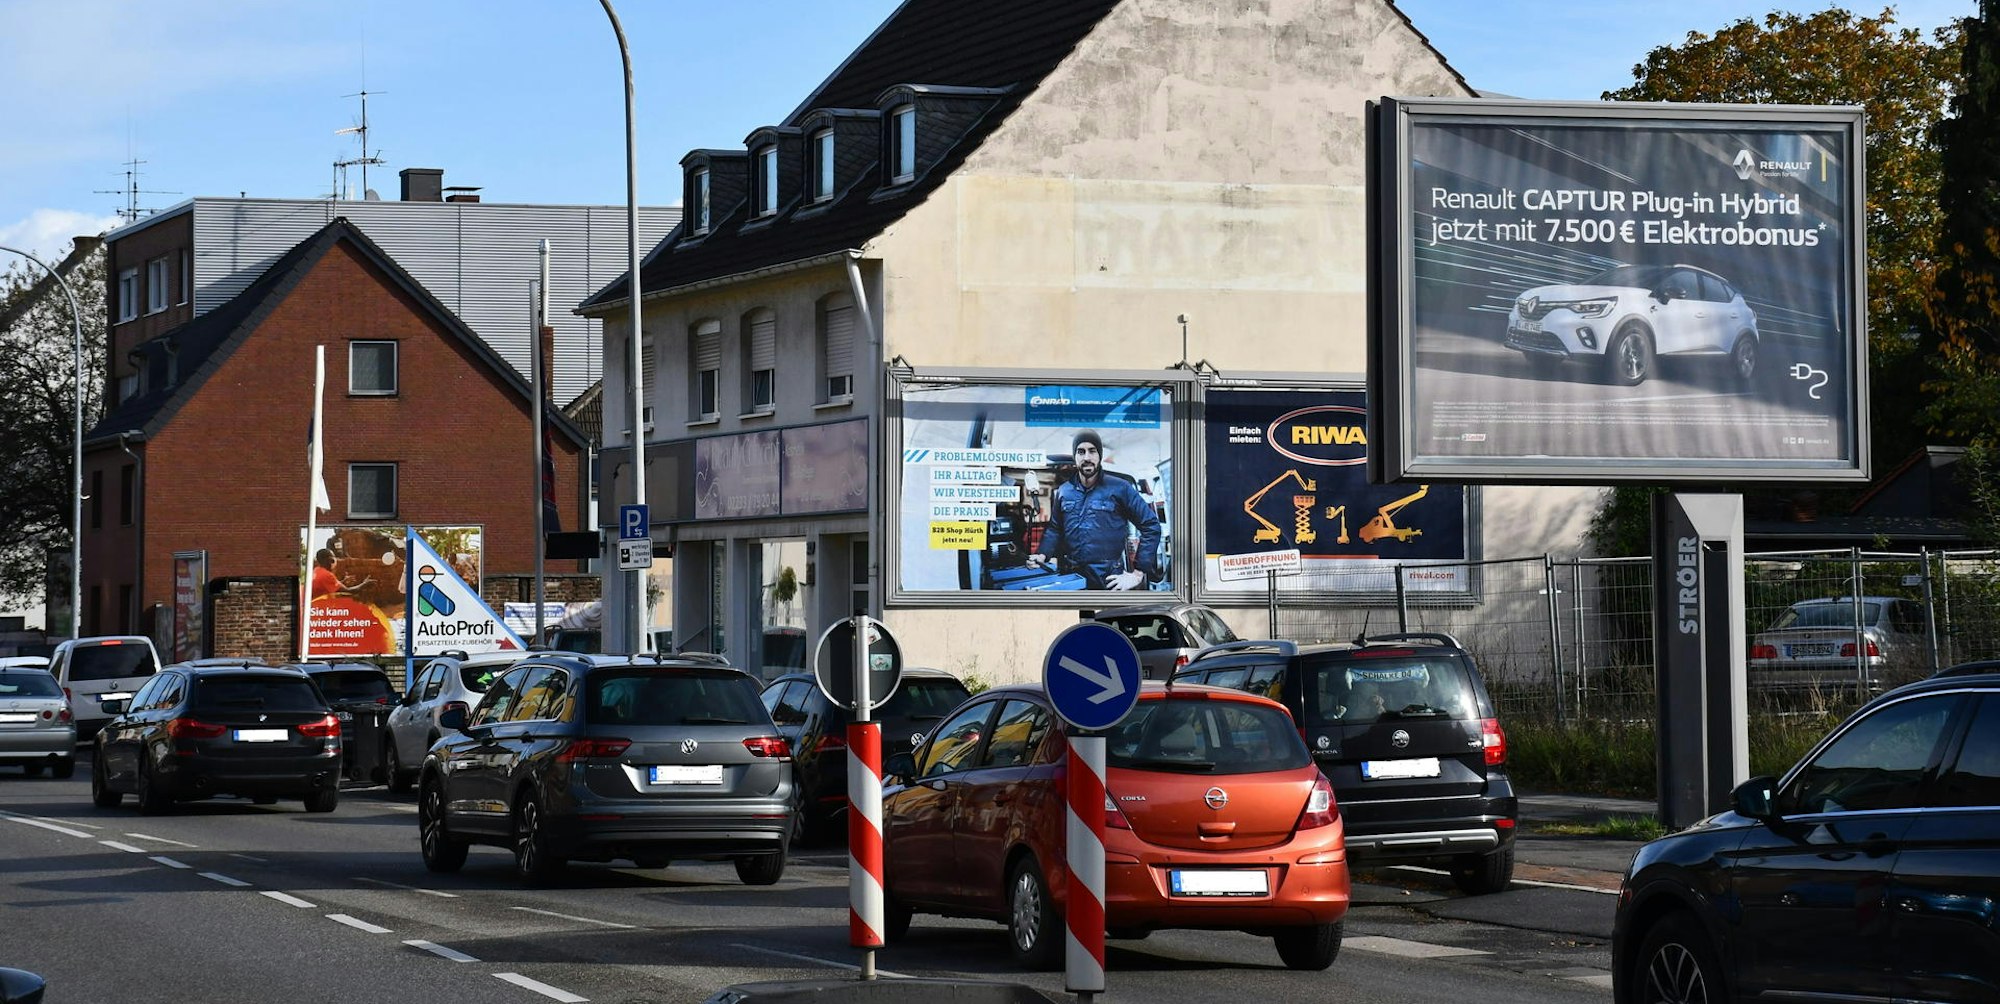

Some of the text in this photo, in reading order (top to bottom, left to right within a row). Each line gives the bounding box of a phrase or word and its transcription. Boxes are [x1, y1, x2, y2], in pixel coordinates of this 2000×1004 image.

[1760, 161, 1812, 170] RENAULT
[1431, 188, 1800, 220] Renault CAPTUR Plug-in Hybrid
[1430, 216, 1488, 246] jetzt
[1495, 218, 1537, 242] mit
[1544, 219, 1616, 243] 7.500
[1619, 220, 1636, 244] €
[1030, 396, 1070, 408] CONRAD
[1229, 426, 1262, 435] Einfach
[1292, 426, 1368, 445] RIWA
[1229, 435, 1262, 444] mieten:
[934, 450, 1042, 463] PROBLEMLÖSUNG IST
[934, 470, 998, 480] IHR ALLTAG?
[934, 488, 1016, 498] WIR VERSTEHEN
[934, 506, 992, 516] DIE PRAXIS.
[626, 509, 642, 538] P
[946, 527, 963, 535] Shop
[1224, 553, 1296, 566] NEUERÖFFNUNG
[1409, 571, 1454, 580] riwal.com
[1676, 536, 1698, 634] STRÖER
[310, 607, 350, 616] Sie kann
[310, 618, 340, 627] wieder
[343, 618, 370, 627] sehen
[418, 620, 494, 636] AutoProfi
[310, 630, 364, 638] dank Ihnen!
